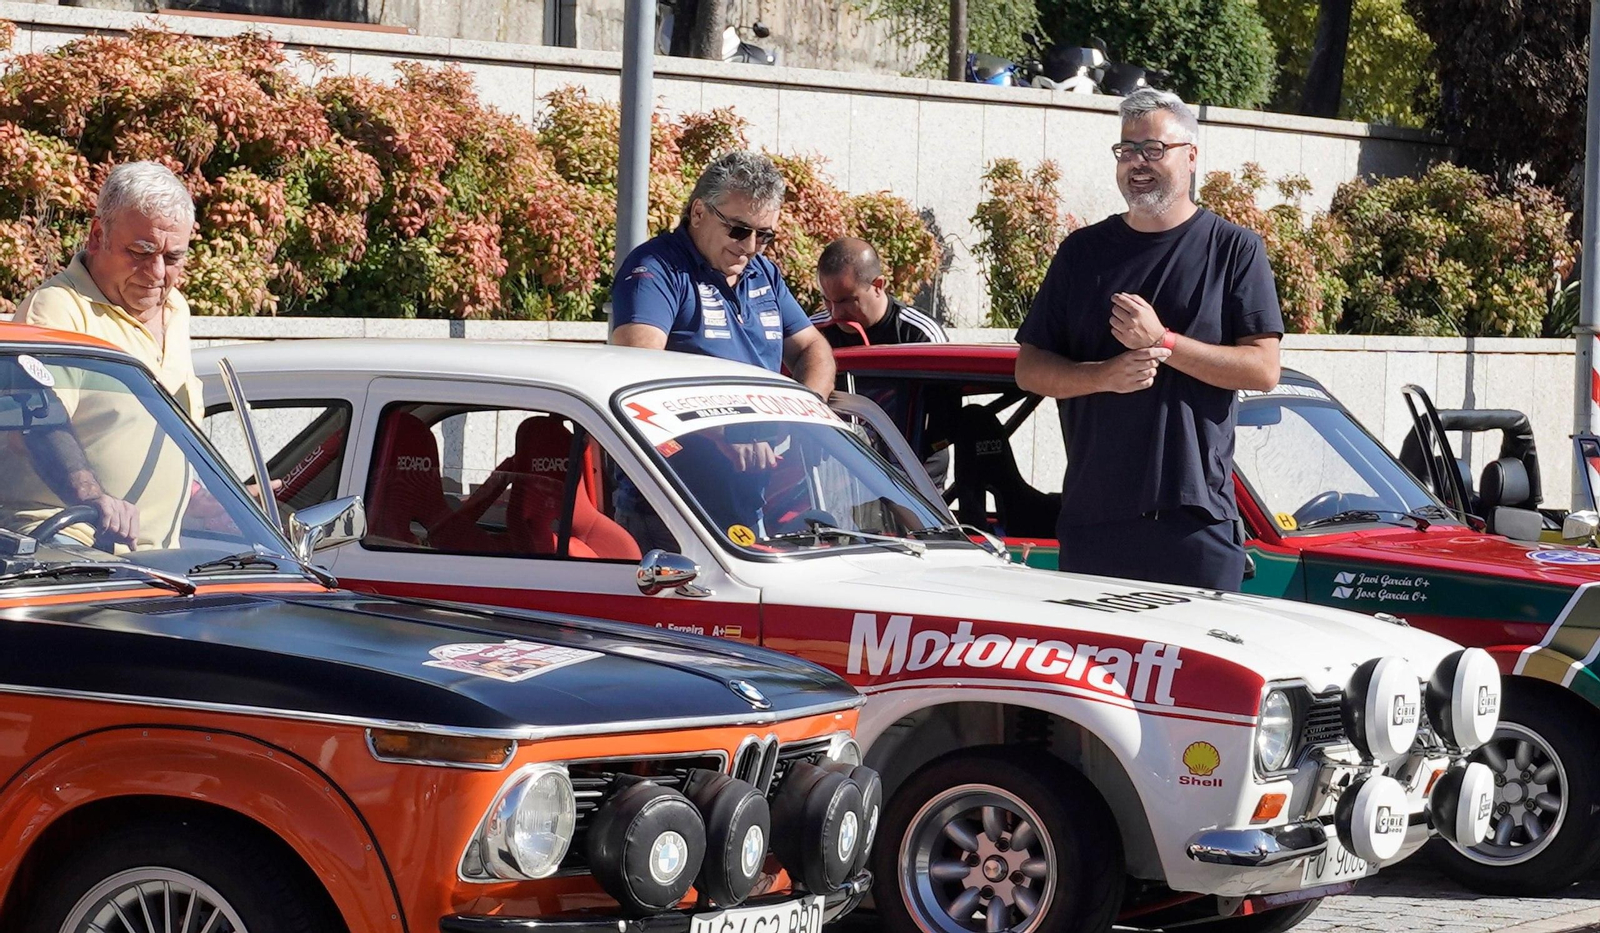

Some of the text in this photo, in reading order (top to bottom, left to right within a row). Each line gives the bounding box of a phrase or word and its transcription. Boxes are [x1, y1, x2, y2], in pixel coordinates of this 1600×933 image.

[397, 456, 432, 471] RECARO
[1277, 514, 1293, 528] H
[732, 527, 752, 543] H
[1357, 572, 1430, 588] Javi García O+
[1354, 587, 1428, 602] Jose García O+
[846, 612, 1183, 706] Motorcraft
[1396, 706, 1416, 716] CIBIE
[1178, 775, 1223, 788] Shell
[1380, 817, 1404, 826] CIBIE
